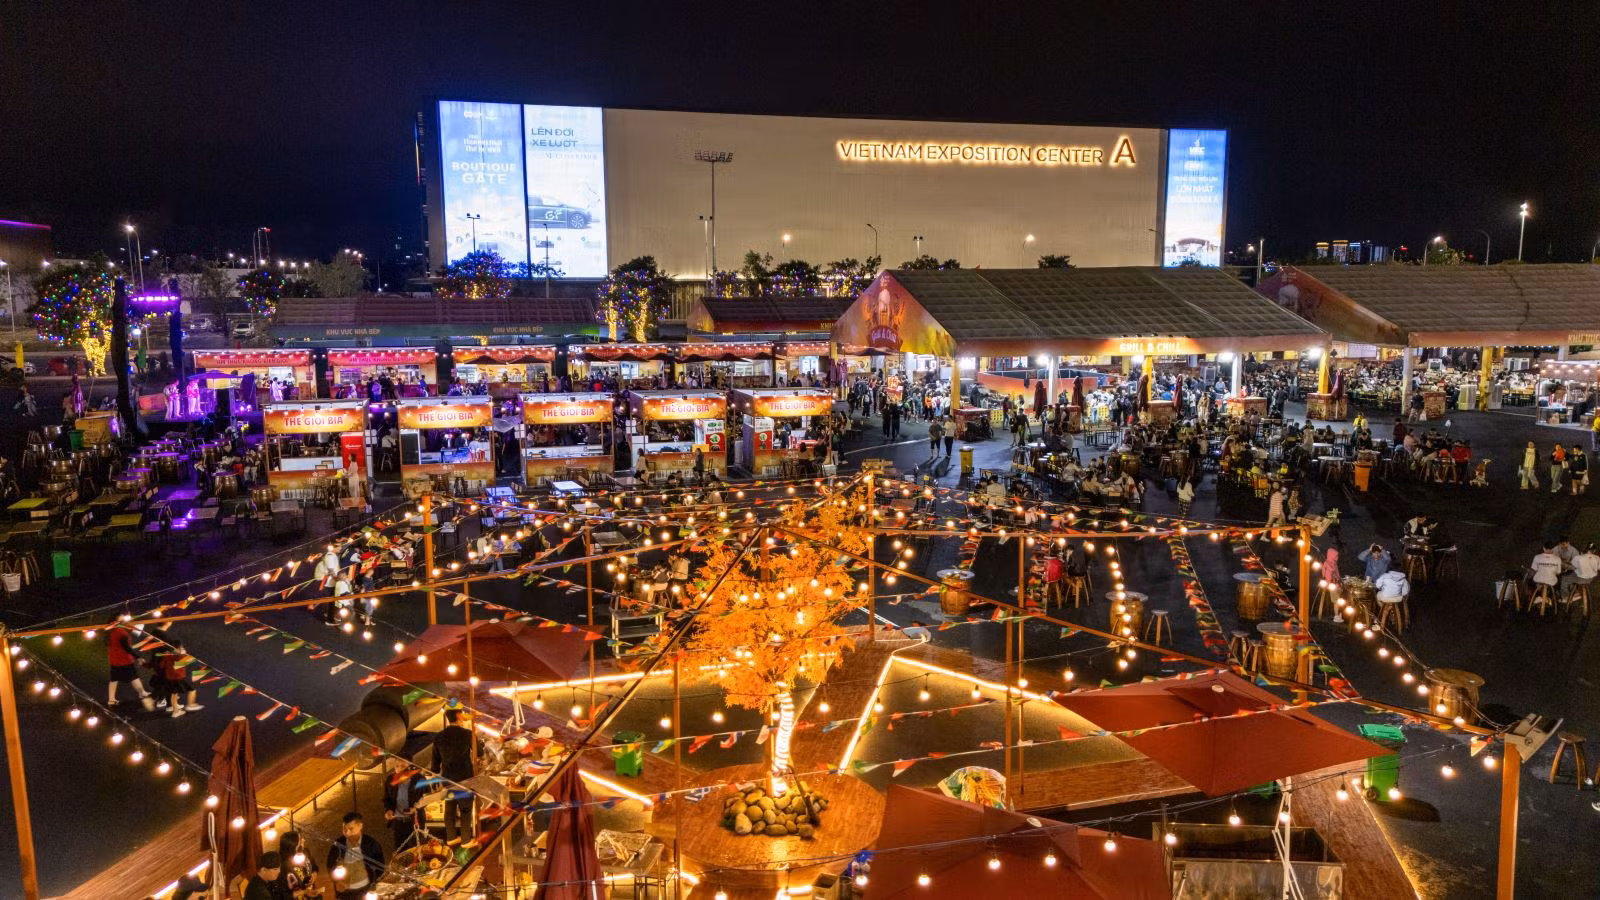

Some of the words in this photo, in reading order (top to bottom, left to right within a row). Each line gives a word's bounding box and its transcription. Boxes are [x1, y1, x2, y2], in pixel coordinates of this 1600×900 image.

[531, 139, 547, 147] XE
[840, 142, 922, 159] VIETNAM
[927, 144, 1031, 162] EXPOSITION
[1036, 147, 1103, 163] CENTER
[1113, 137, 1137, 164] A
[462, 171, 507, 185] GATE
[1120, 342, 1145, 353] GRILL
[580, 408, 595, 416] BIA
[696, 404, 710, 412] BIA
[458, 412, 474, 420] BIA
[327, 416, 344, 425] BIA
